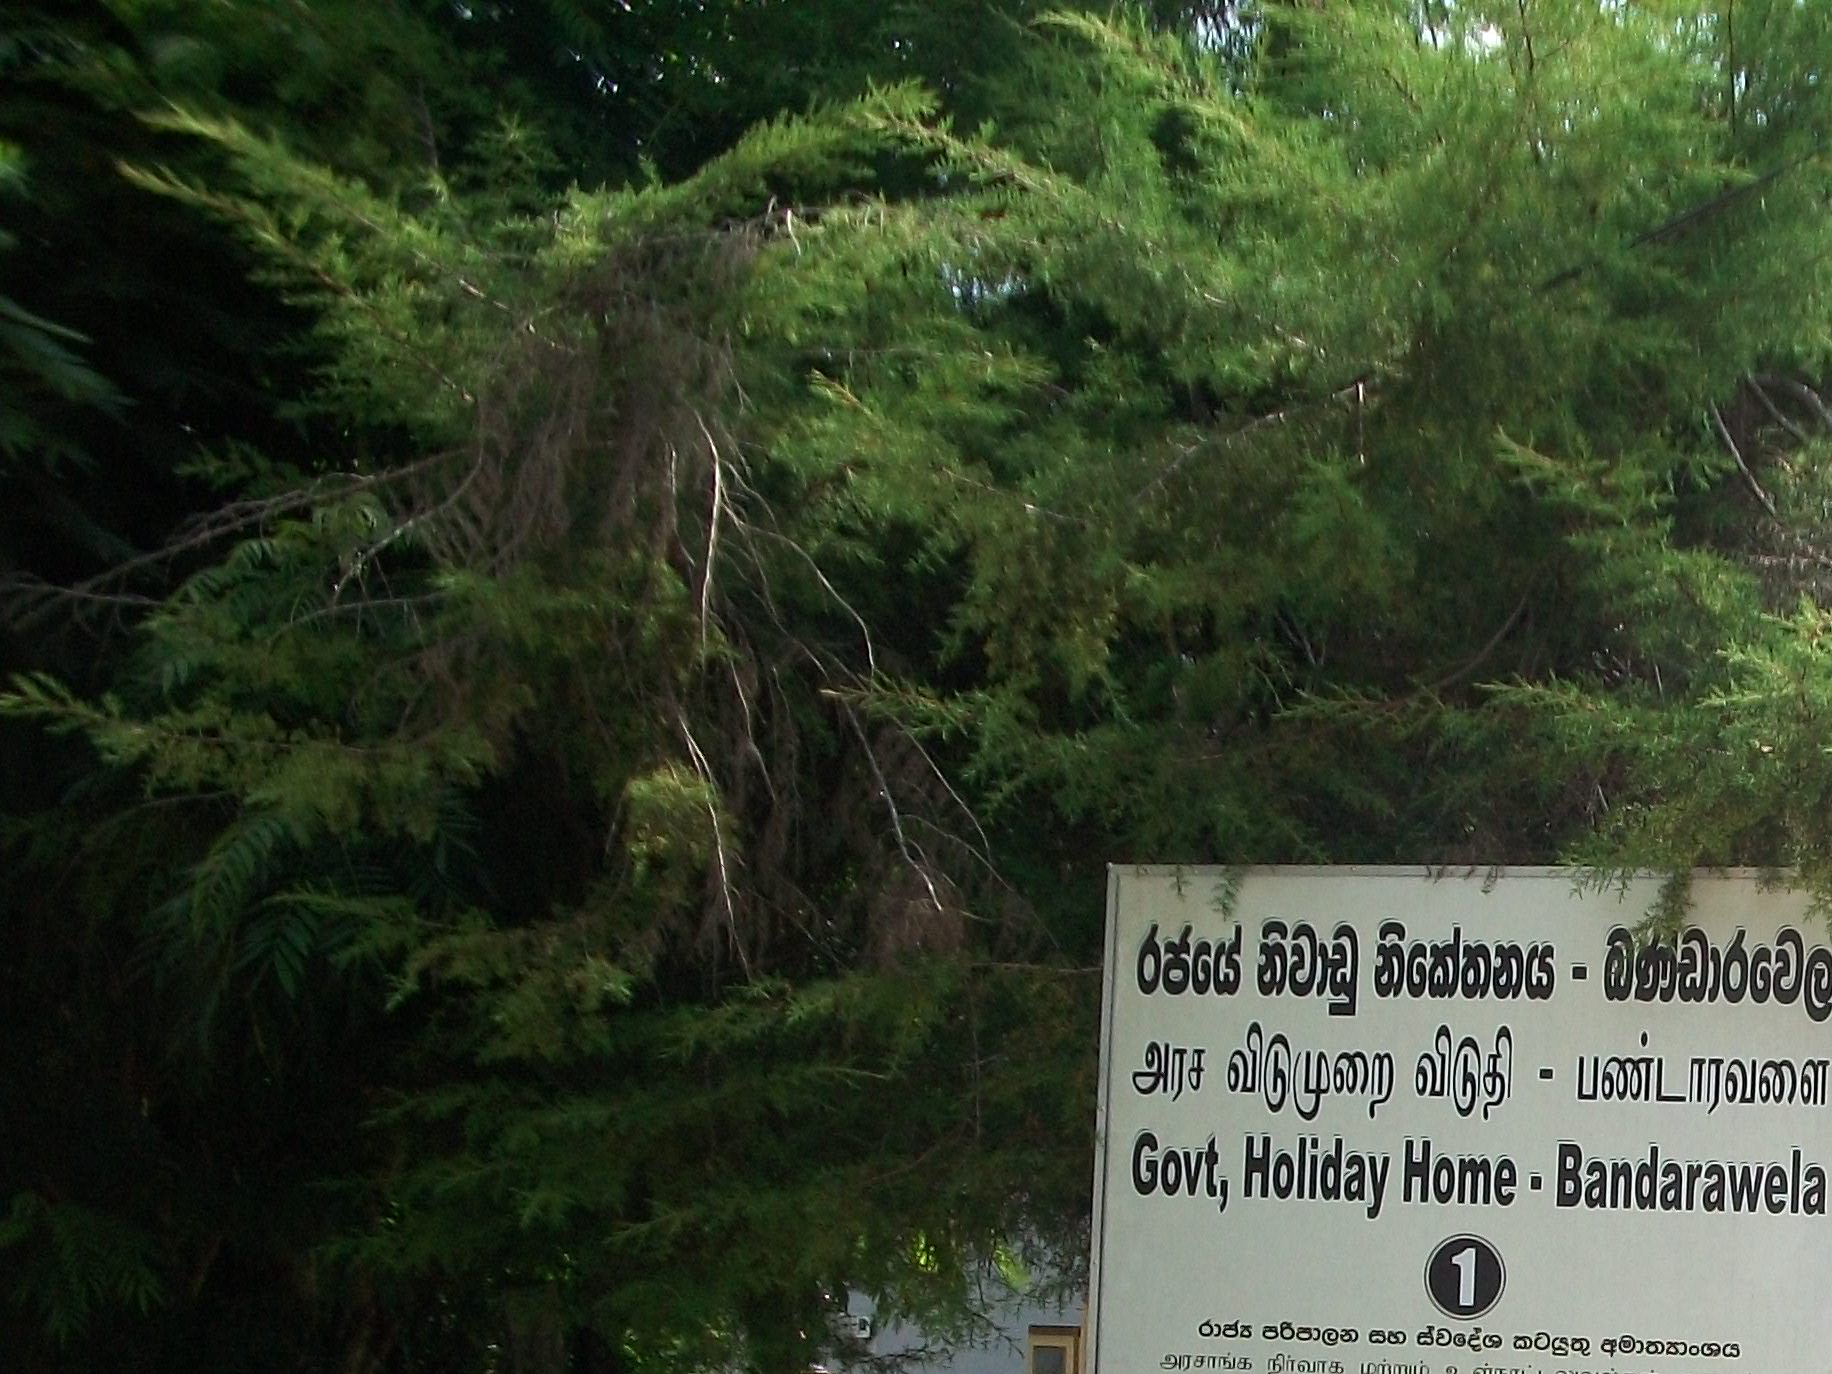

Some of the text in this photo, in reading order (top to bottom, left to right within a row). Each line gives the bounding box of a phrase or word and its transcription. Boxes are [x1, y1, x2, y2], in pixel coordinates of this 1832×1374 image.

[1136, 923, 1242, 996] රජයේ
[1256, 920, 1359, 1017] නිවාඩු
[1374, 921, 1555, 1001] නිකේතනය
[1132, 1041, 1206, 1102] அரச
[1227, 1021, 1394, 1121] விடுமுறை
[1415, 1024, 1513, 1121] விடுதி
[1577, 1031, 1830, 1115] பண்டாரவளை
[1132, 1132, 1229, 1213] Govt,
[1243, 1135, 1390, 1219] Holiday
[1403, 1139, 1517, 1206] Home
[1556, 1139, 1826, 1216] Bandarawela
[1446, 1246, 1479, 1308] 1
[1159, 1352, 1254, 1372] அரசாங்க
[1198, 1319, 1253, 1339] රාජ්‍ය
[1262, 1321, 1359, 1347] පරිපාලන
[1368, 1329, 1407, 1345] සහ
[1416, 1325, 1503, 1353] ස්වදේශ
[1513, 1331, 1591, 1357] කටයුතු
